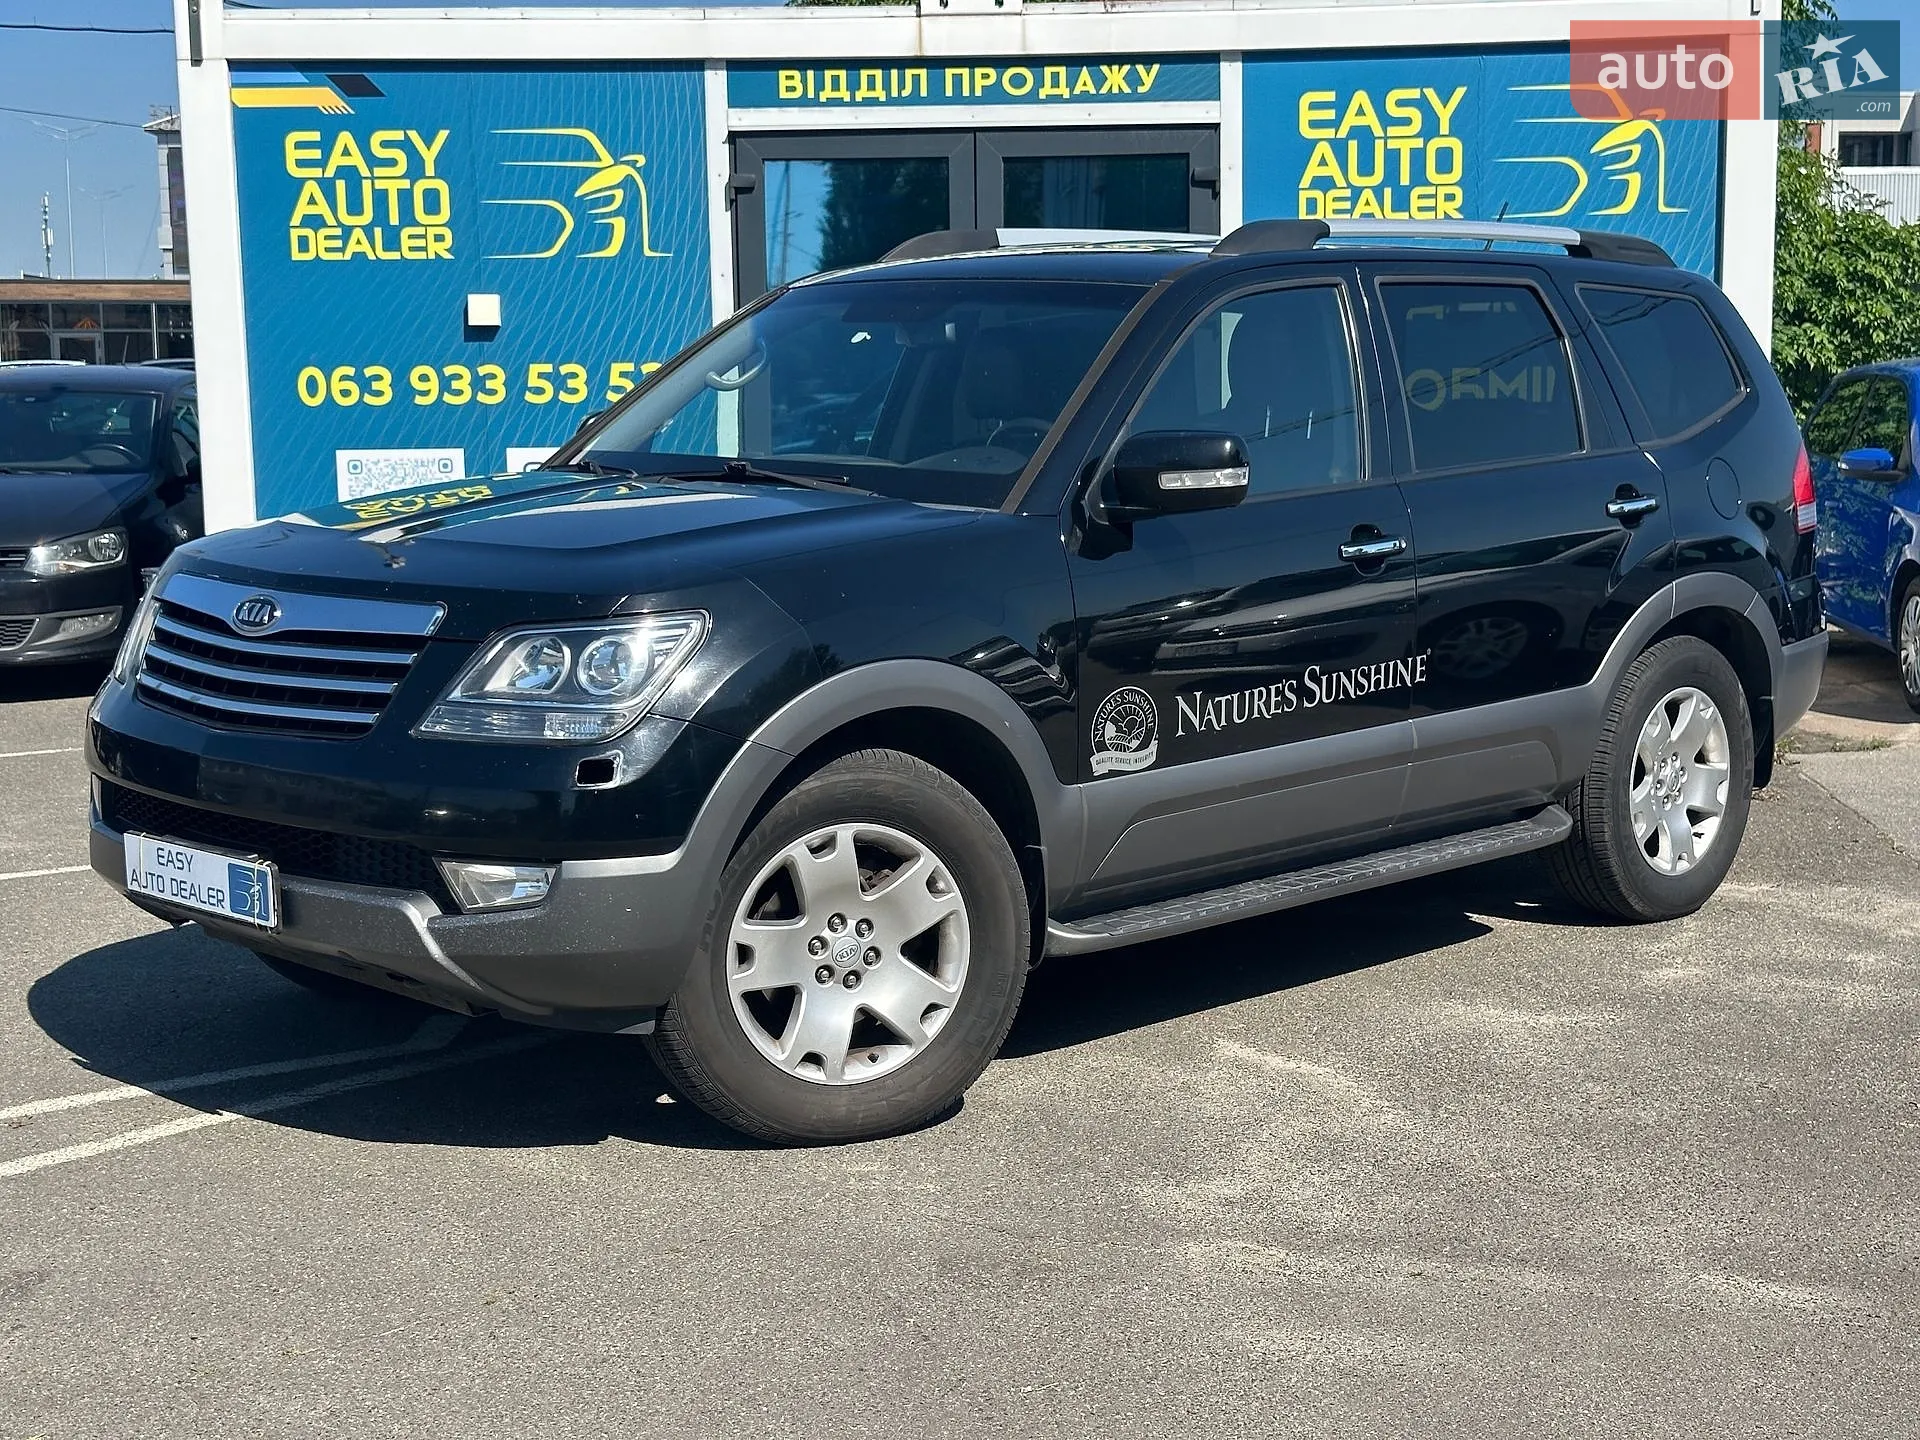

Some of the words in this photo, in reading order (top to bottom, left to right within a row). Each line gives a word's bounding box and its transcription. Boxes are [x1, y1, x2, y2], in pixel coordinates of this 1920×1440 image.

[778, 67, 929, 103] ВІДДІЛ
[944, 63, 1161, 99] ПРОДАЖУ
[1298, 86, 1468, 140] EASY
[285, 129, 450, 178] EASY
[1298, 136, 1464, 189] AUTO
[289, 178, 452, 227] AUTO
[1298, 185, 1465, 220] DEALER
[290, 226, 455, 261] DEALER
[297, 365, 393, 407] 063
[409, 364, 506, 405] 933
[524, 363, 588, 404] 53
[1175, 679, 1298, 738] NATURE'S
[156, 847, 194, 873] EASY
[130, 868, 165, 894] AUTO
[170, 877, 225, 909] DEALER
